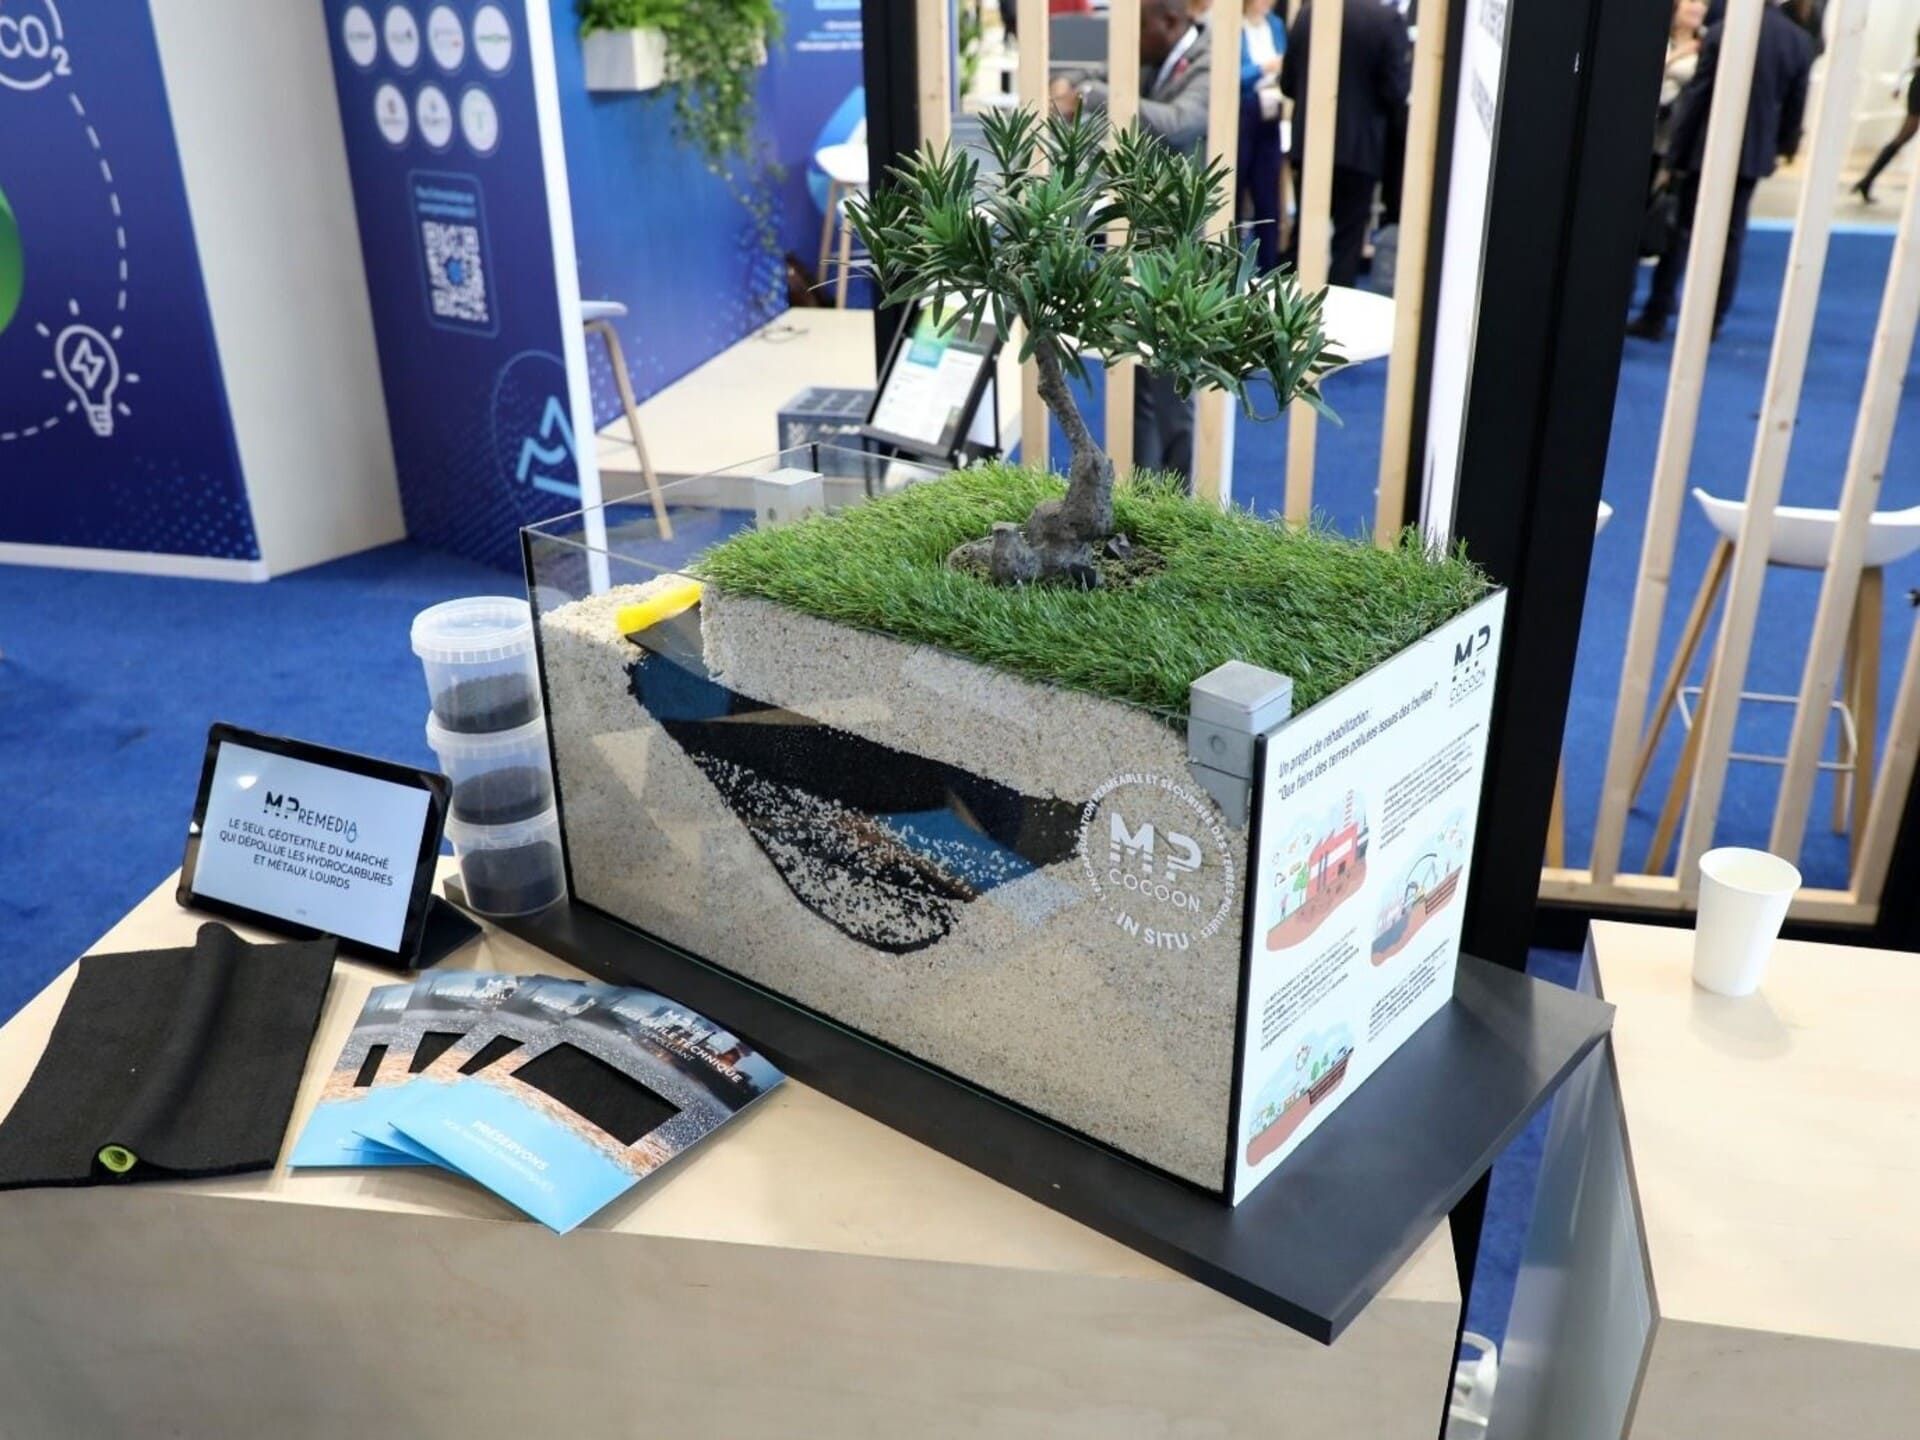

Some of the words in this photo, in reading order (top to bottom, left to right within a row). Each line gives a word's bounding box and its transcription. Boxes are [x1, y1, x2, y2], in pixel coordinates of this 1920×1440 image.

[1145, 774, 1159, 786] ET
[229, 817, 241, 830] LE
[242, 821, 265, 838] SEUL
[328, 844, 343, 857] DU
[1108, 811, 1202, 882] MP
[219, 830, 236, 844] QUI
[237, 833, 286, 857] DÉPOLLUE
[287, 848, 305, 864] LES
[305, 853, 394, 887] HYDROCARBURES
[253, 853, 266, 867] ET
[267, 857, 307, 878] MÉTAUX
[309, 868, 351, 890] LOURDS
[1109, 868, 1200, 913] COCOON
[1116, 911, 1140, 938] IN
[1143, 927, 1190, 951] SITU
[680, 1036, 743, 1083] TECHNIQUE
